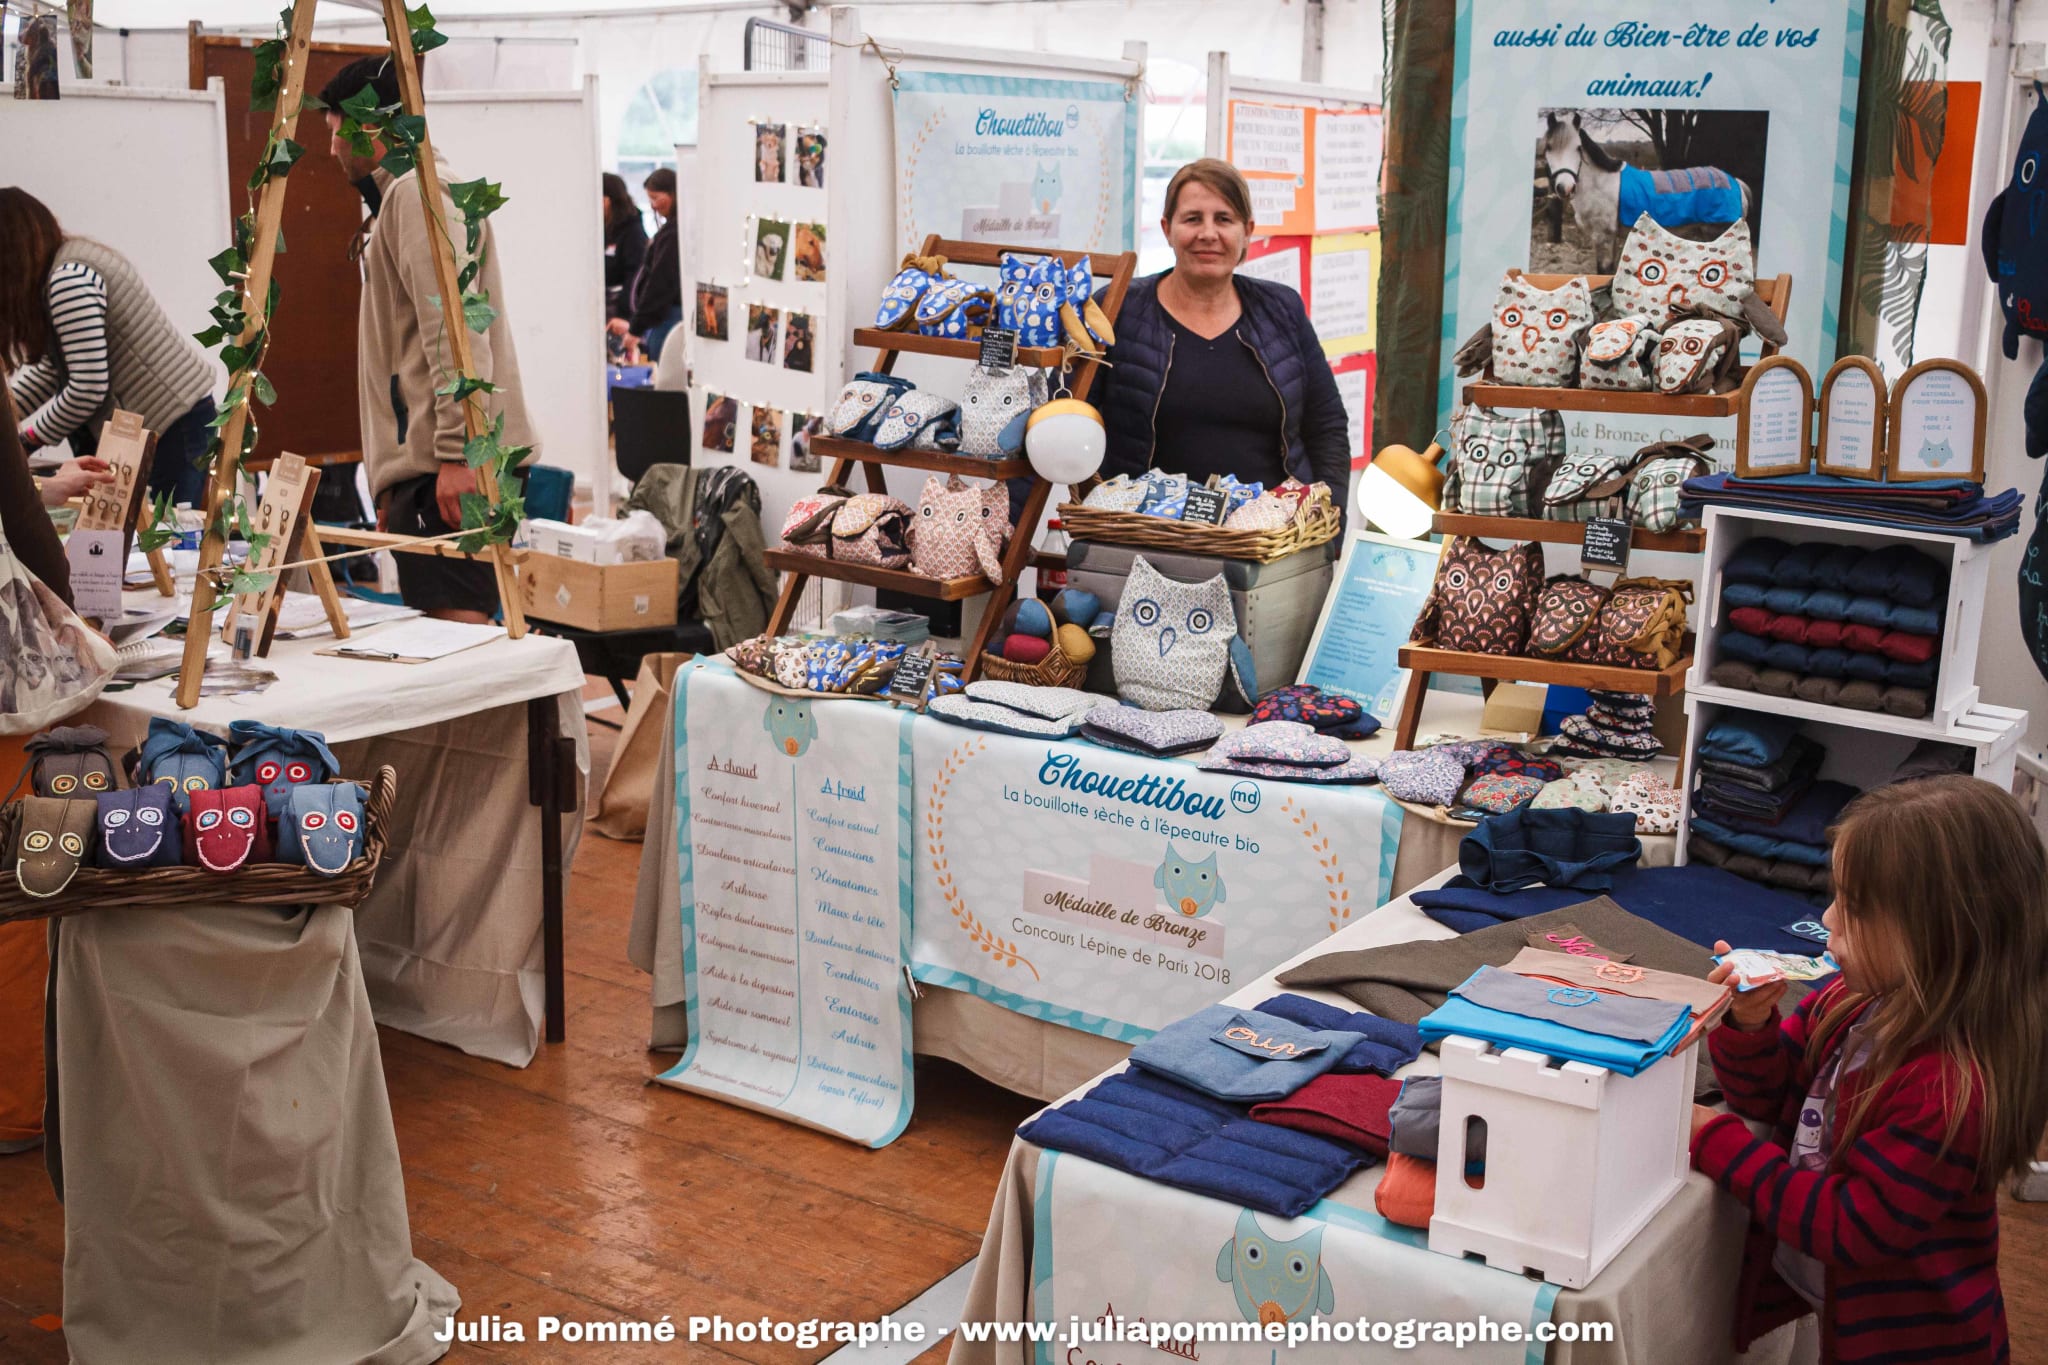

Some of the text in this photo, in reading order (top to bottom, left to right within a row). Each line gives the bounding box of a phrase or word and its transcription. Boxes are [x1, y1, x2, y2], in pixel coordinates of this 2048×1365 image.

[1493, 21, 1821, 49] aussi du Bien-être de vos
[1586, 72, 1713, 98] animaux!
[976, 106, 1064, 137] Chouettibou
[1570, 421, 1589, 438] de
[707, 755, 758, 779] A chaud
[821, 777, 866, 802] A froid
[1038, 748, 1226, 820] Chouettibou
[700, 786, 781, 814] Confort hivernal
[807, 808, 880, 836] Confort estival
[1003, 785, 1260, 854] La bouillotte sèche à l'épeautre bio
[697, 843, 797, 875] Douleurs articulaires
[813, 836, 875, 863] Contusions
[721, 880, 768, 900] Arthrose
[811, 866, 879, 896] Hématomes
[696, 900, 795, 935] Règles douloureuses
[815, 899, 886, 928] Maux de tête
[1044, 890, 1207, 948] Médaille de Bronze
[738, 944, 748, 954] du
[804, 930, 897, 965] Douleurs dentaires
[1012, 918, 1231, 984] Concours Lépine de Paris 2018
[701, 965, 729, 981] Aide
[739, 974, 749, 986] la
[751, 979, 795, 999] digestion
[824, 961, 880, 991] Tendinites
[707, 996, 793, 1028] Aide au sommeil
[825, 996, 880, 1025] Entorses
[750, 1043, 760, 1054] de
